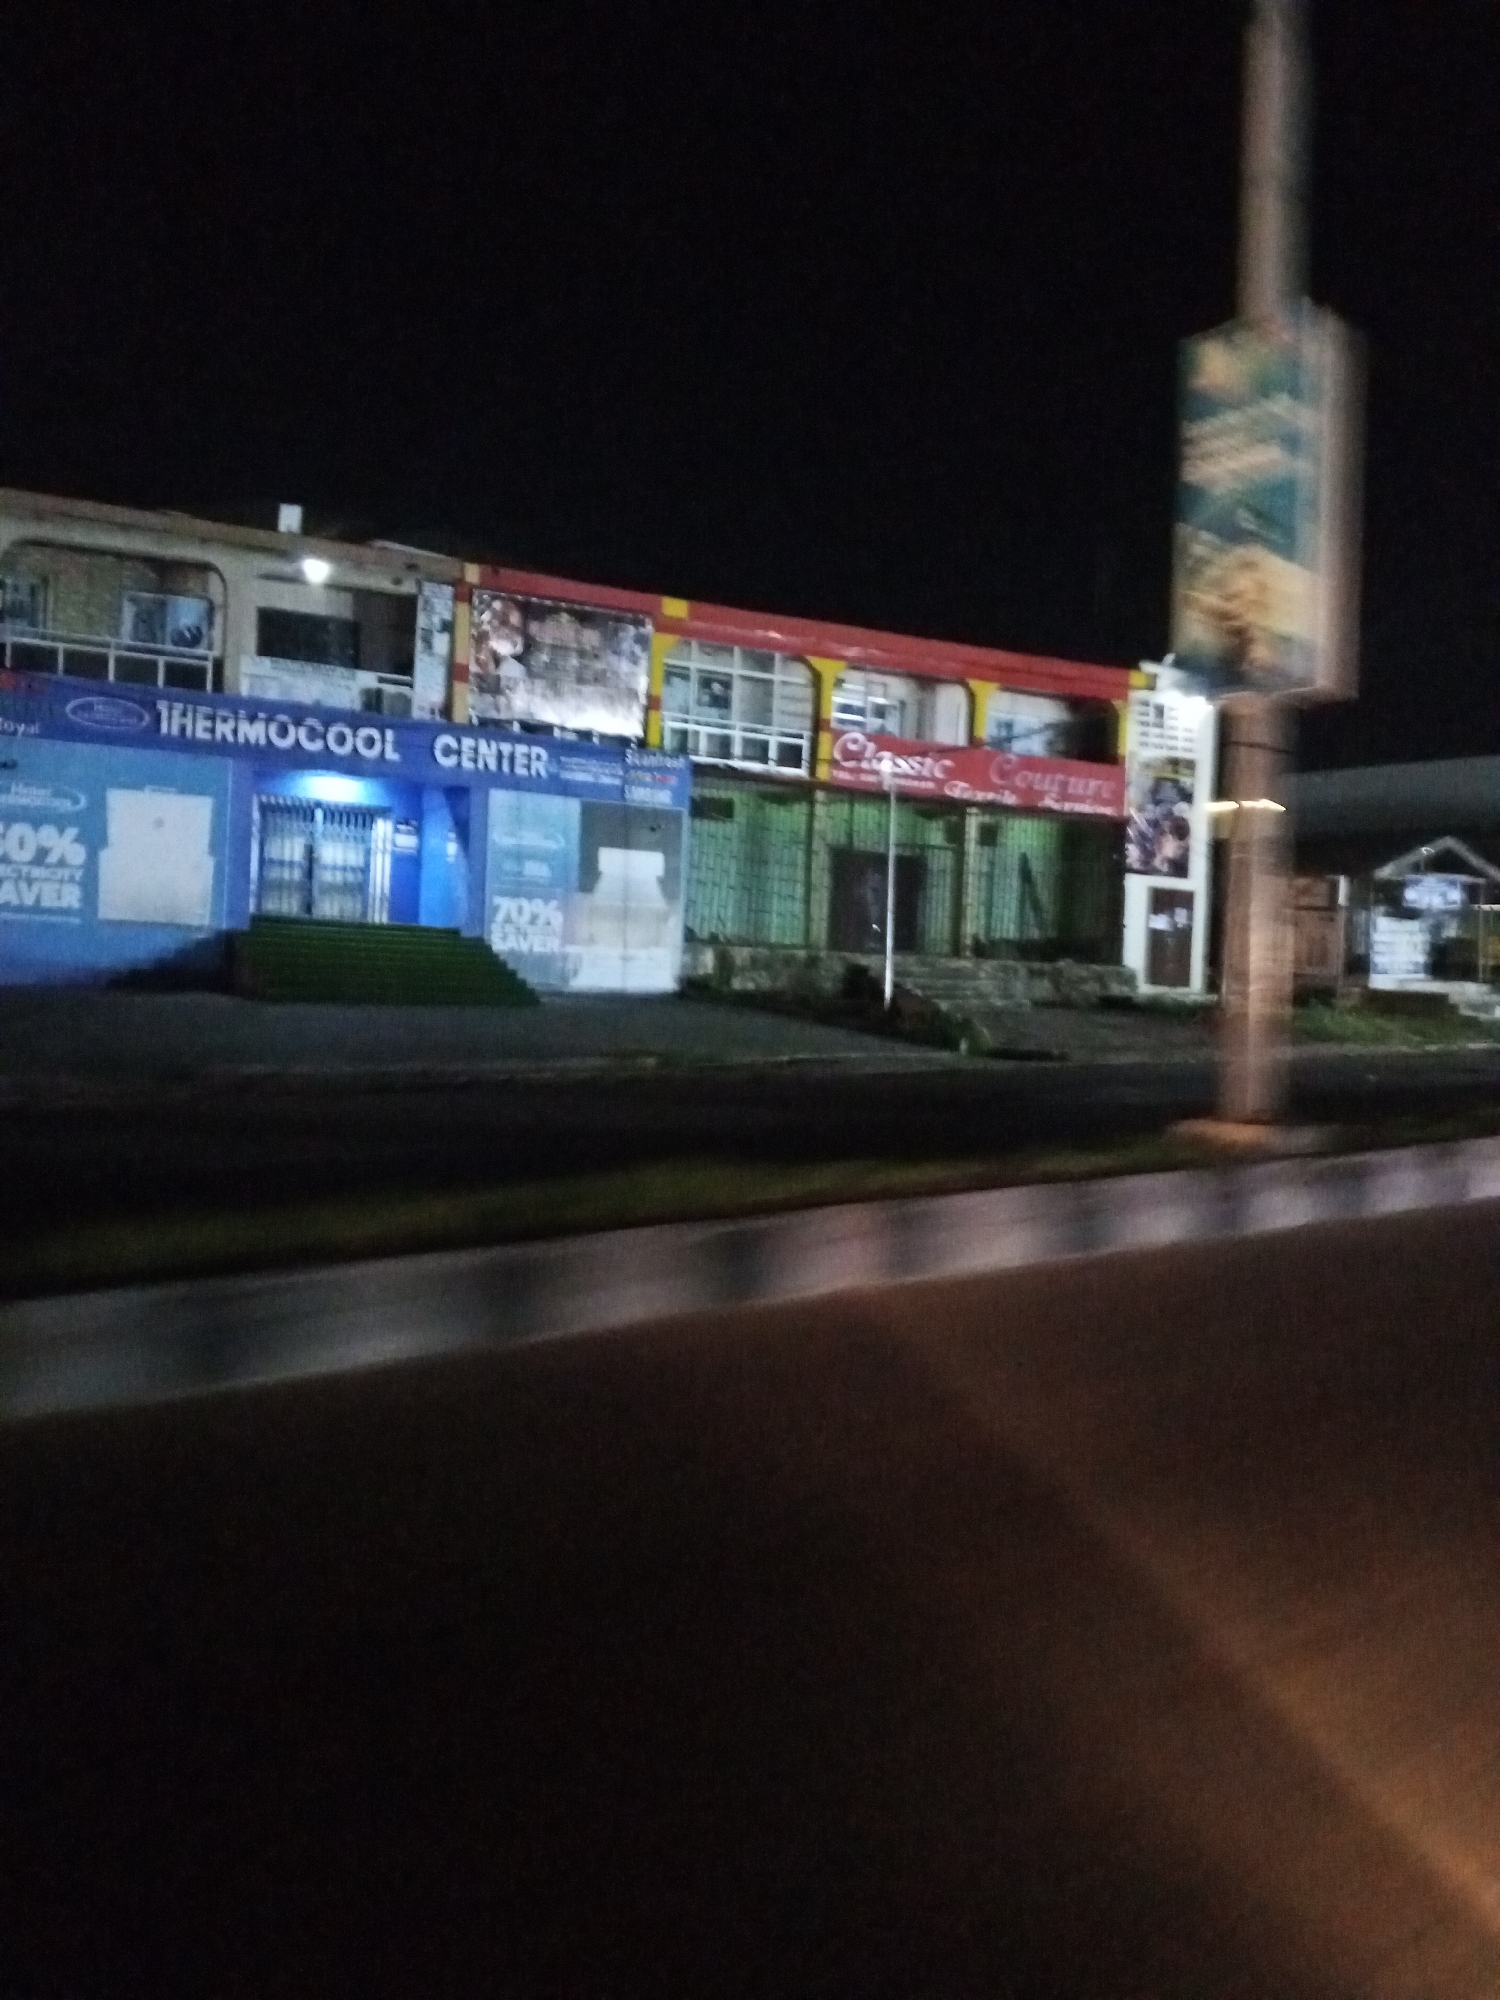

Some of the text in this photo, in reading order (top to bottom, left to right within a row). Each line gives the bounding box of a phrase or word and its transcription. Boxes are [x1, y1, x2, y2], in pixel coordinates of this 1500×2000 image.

[156, 700, 400, 762] THERMOCOOL
[433, 734, 548, 778] CENTER
[833, 732, 954, 780] Classic
[989, 753, 1117, 799] Couture
